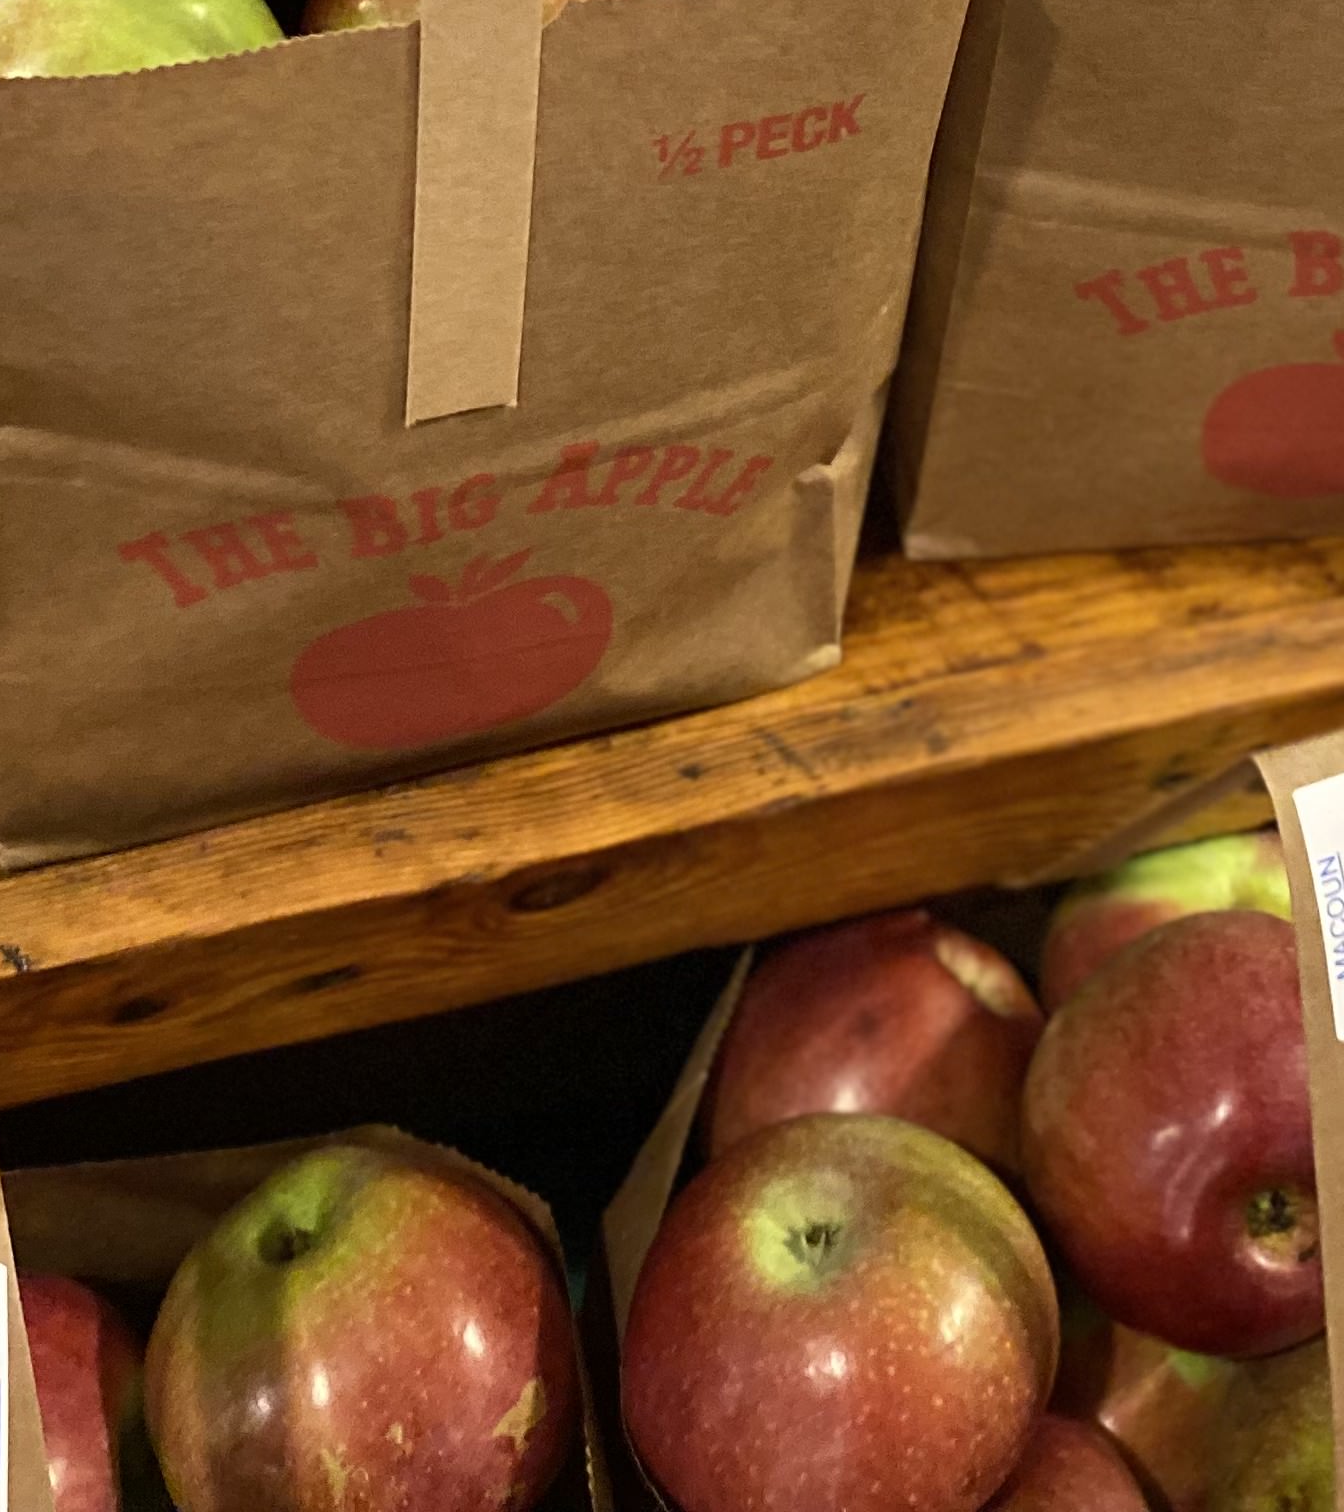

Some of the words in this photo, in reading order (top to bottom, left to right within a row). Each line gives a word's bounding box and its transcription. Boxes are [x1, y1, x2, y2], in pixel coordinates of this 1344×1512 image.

[717, 92, 866, 169] PECK
[1074, 246, 1259, 337] THE
[117, 510, 320, 610] THE
[336, 471, 503, 560] BIG
[527, 439, 775, 517] APPLE
